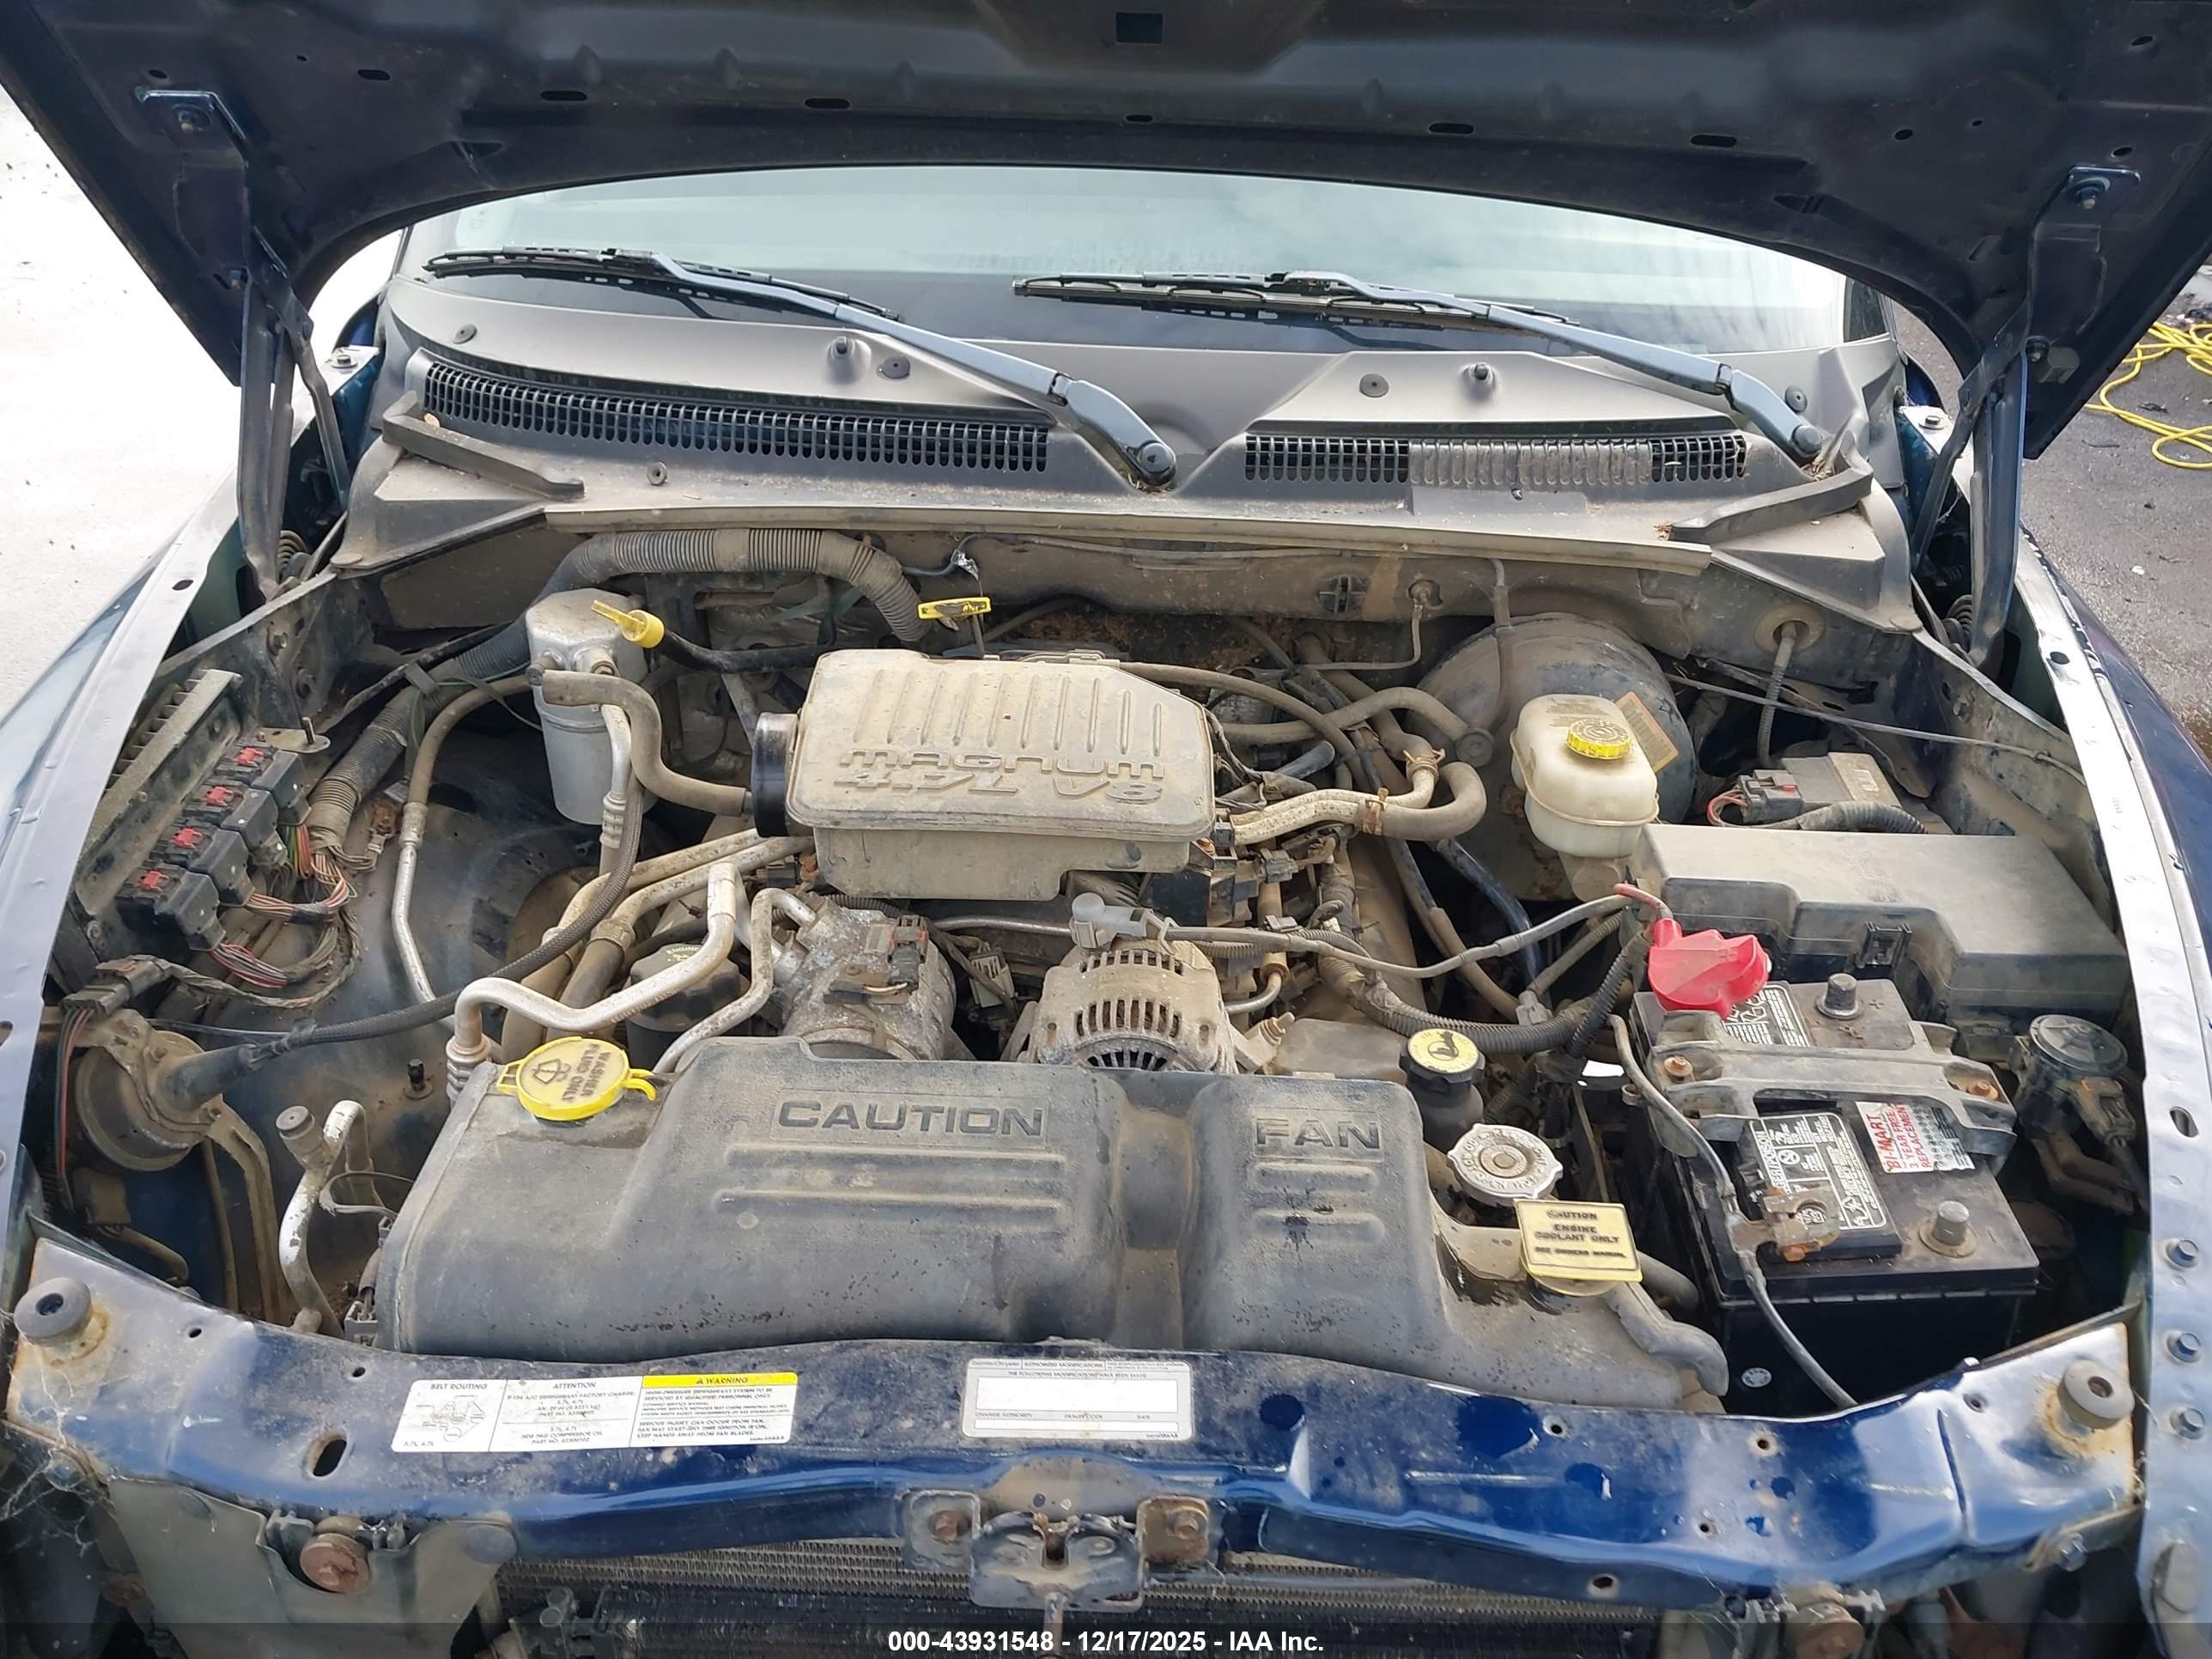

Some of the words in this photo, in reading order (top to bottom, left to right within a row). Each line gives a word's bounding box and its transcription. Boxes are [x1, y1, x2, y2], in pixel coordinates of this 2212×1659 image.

[835, 769, 1019, 795] 4.7L
[1054, 775, 1164, 804] V8
[561, 1075, 585, 1103] ONLY
[580, 1052, 611, 1097] WASHER
[778, 1100, 1045, 1137] CAUTION
[1887, 1110, 1903, 1133] FREE
[1255, 1118, 1380, 1150] FAN
[1865, 1113, 1902, 1170] BI-MART
[1896, 1104, 1932, 1169] REPLACEMEN
[1896, 1134, 1915, 1159] YEAR
[1547, 1210, 1597, 1220] CAUTION
[1553, 1224, 1598, 1233] ENGINE
[1534, 1231, 1586, 1242] COOLANT
[1590, 1234, 1620, 1243] ONLY
